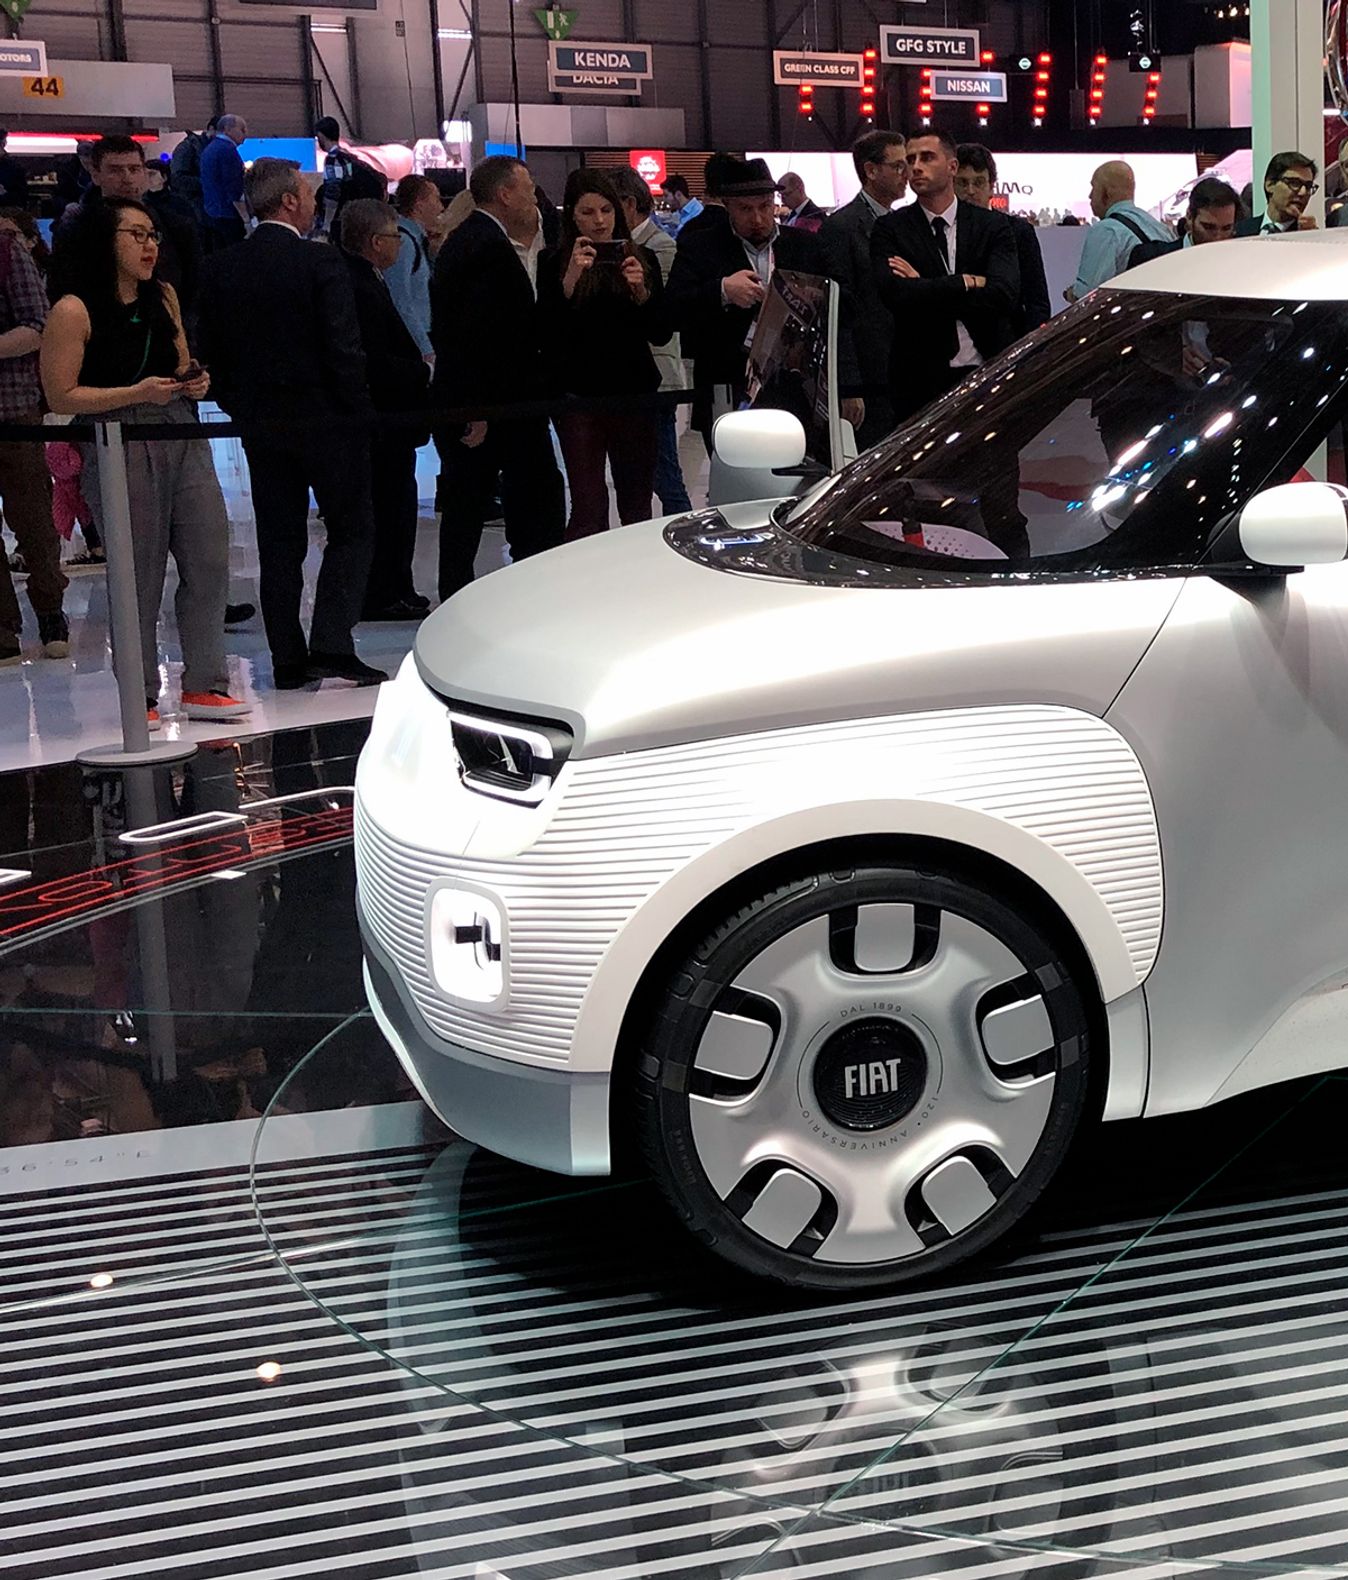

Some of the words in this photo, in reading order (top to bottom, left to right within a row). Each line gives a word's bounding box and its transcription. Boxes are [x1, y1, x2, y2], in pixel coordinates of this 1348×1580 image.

[895, 38, 924, 52] GFG
[926, 40, 967, 55] STYLE
[574, 51, 632, 69] KENDA
[783, 63, 812, 74] GREEN
[813, 65, 839, 75] CLASS
[840, 66, 856, 76] CFF
[30, 77, 59, 97] 44
[946, 79, 991, 94] NISSAN
[840, 1004, 865, 1018] DAL
[873, 1002, 902, 1013] 1899
[844, 1058, 902, 1099] FIAT
[802, 1109, 909, 1151] ANNIVERSARIO
